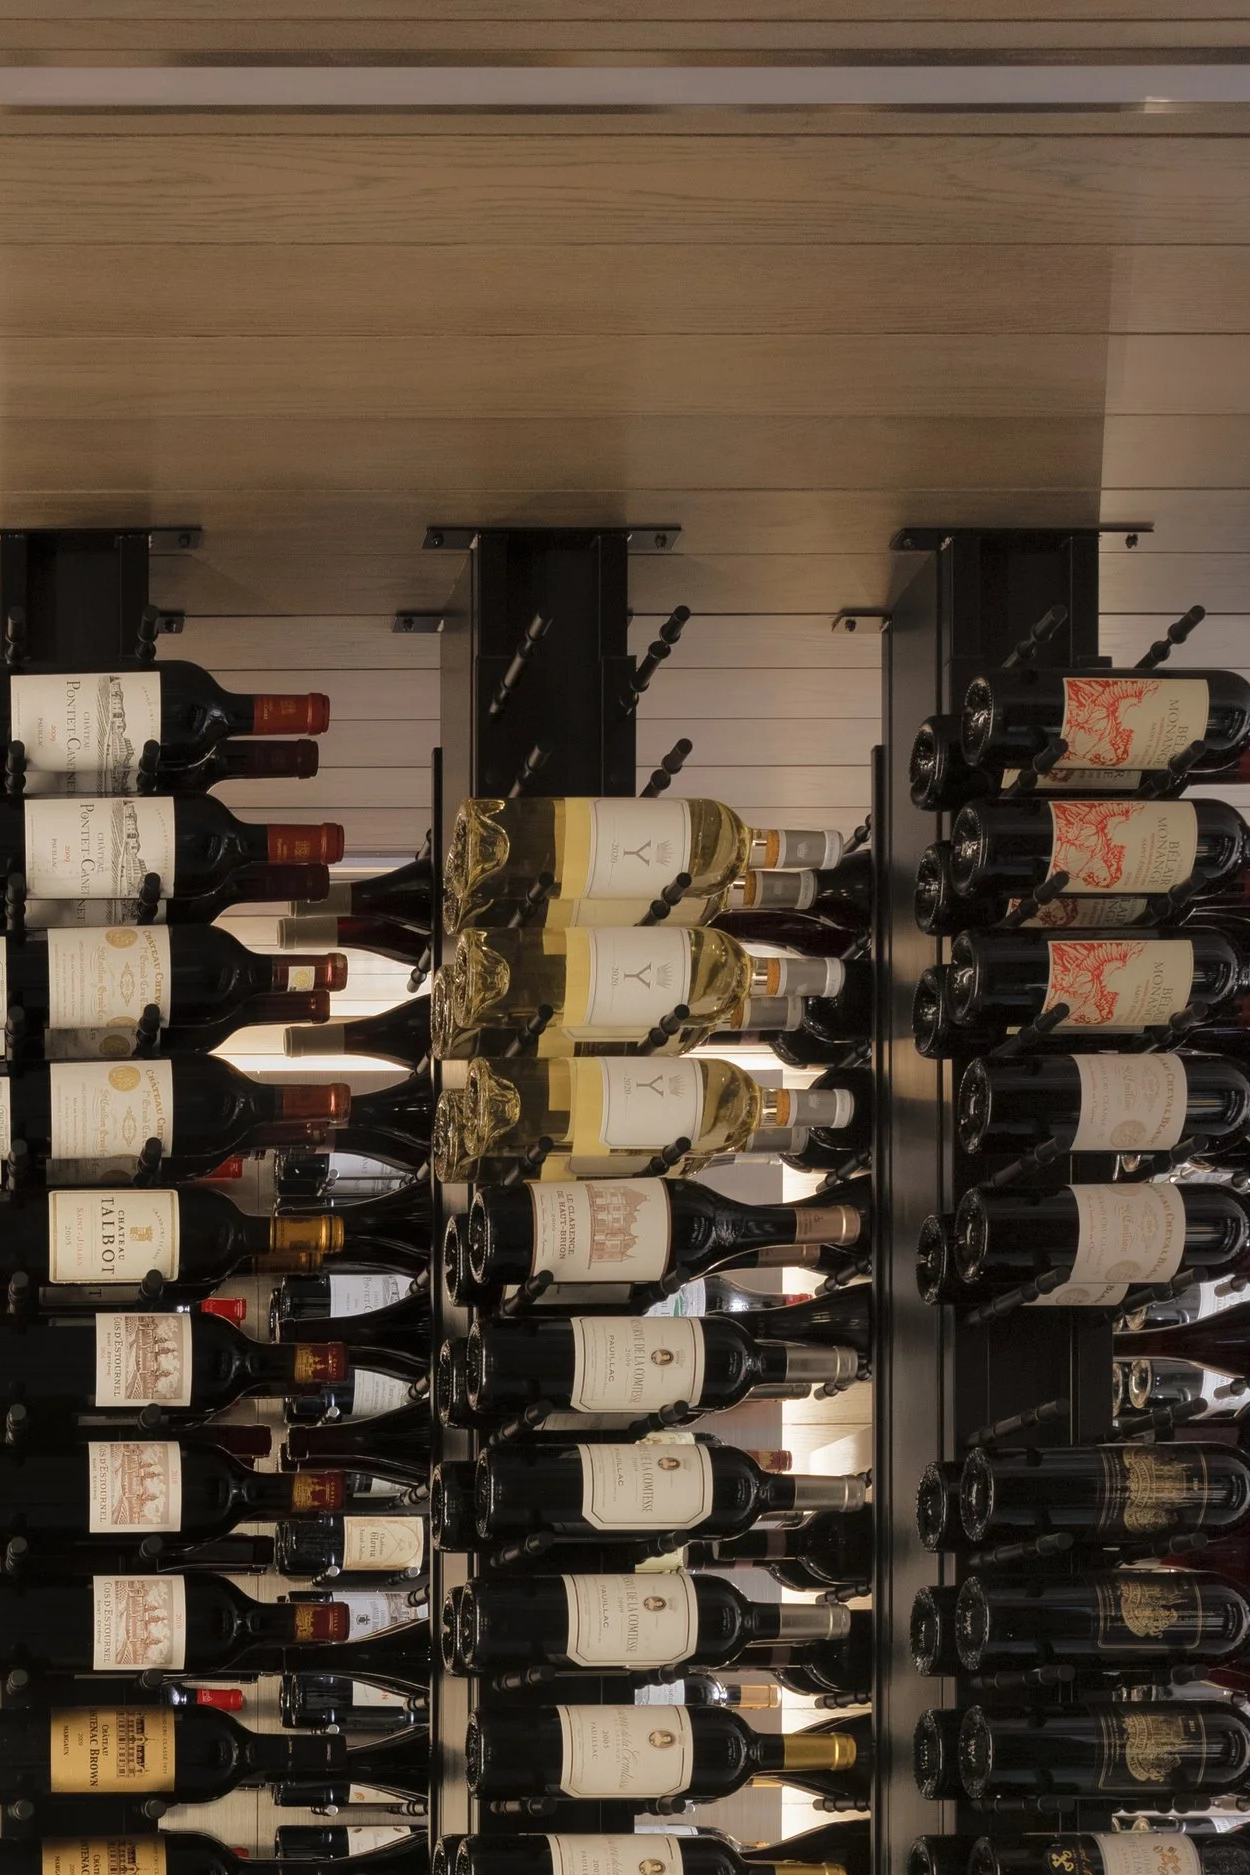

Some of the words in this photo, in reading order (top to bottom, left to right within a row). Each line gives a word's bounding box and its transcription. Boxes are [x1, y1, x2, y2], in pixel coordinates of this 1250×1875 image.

[610, 842, 619, 865] 2020
[623, 840, 651, 866] Y
[610, 966, 619, 987] 2020
[623, 962, 652, 990] Y
[635, 1074, 664, 1098] Y
[1161, 1072, 1176, 1115] CHEVAL
[101, 1196, 115, 1275] TALBOT
[556, 1201, 567, 1260] HAUT-BRION
[565, 1205, 575, 1255] CLARENCE
[1158, 1213, 1176, 1256] CHEVAL
[641, 1473, 654, 1512] COMTESSE
[599, 1584, 610, 1628] PAUILLAC
[624, 1613, 638, 1652] COMTESSE
[89, 1749, 99, 1787] BROWN
